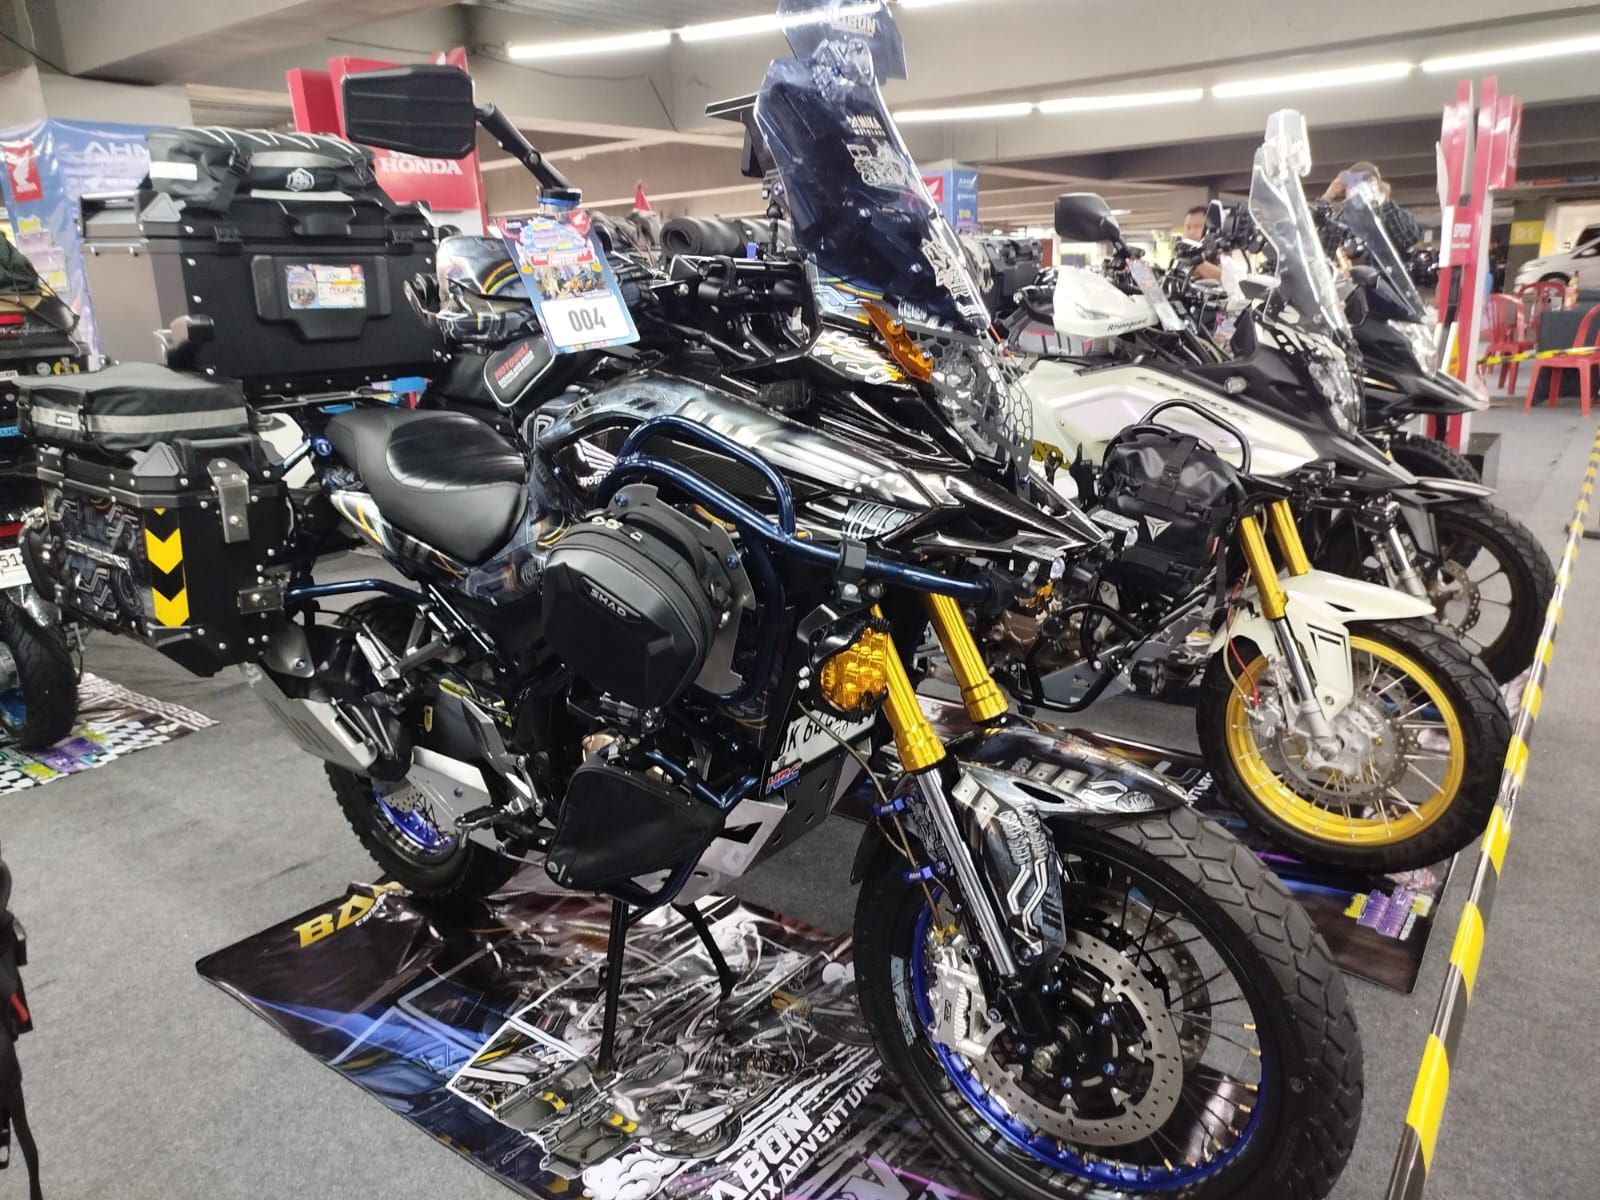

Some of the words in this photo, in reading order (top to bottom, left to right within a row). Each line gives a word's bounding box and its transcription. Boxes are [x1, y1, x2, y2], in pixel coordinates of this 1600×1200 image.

[379, 157, 463, 176] HONDA
[568, 307, 607, 332] 004
[590, 588, 627, 617] SHAD
[778, 1067, 882, 1184] ADVENTURE
